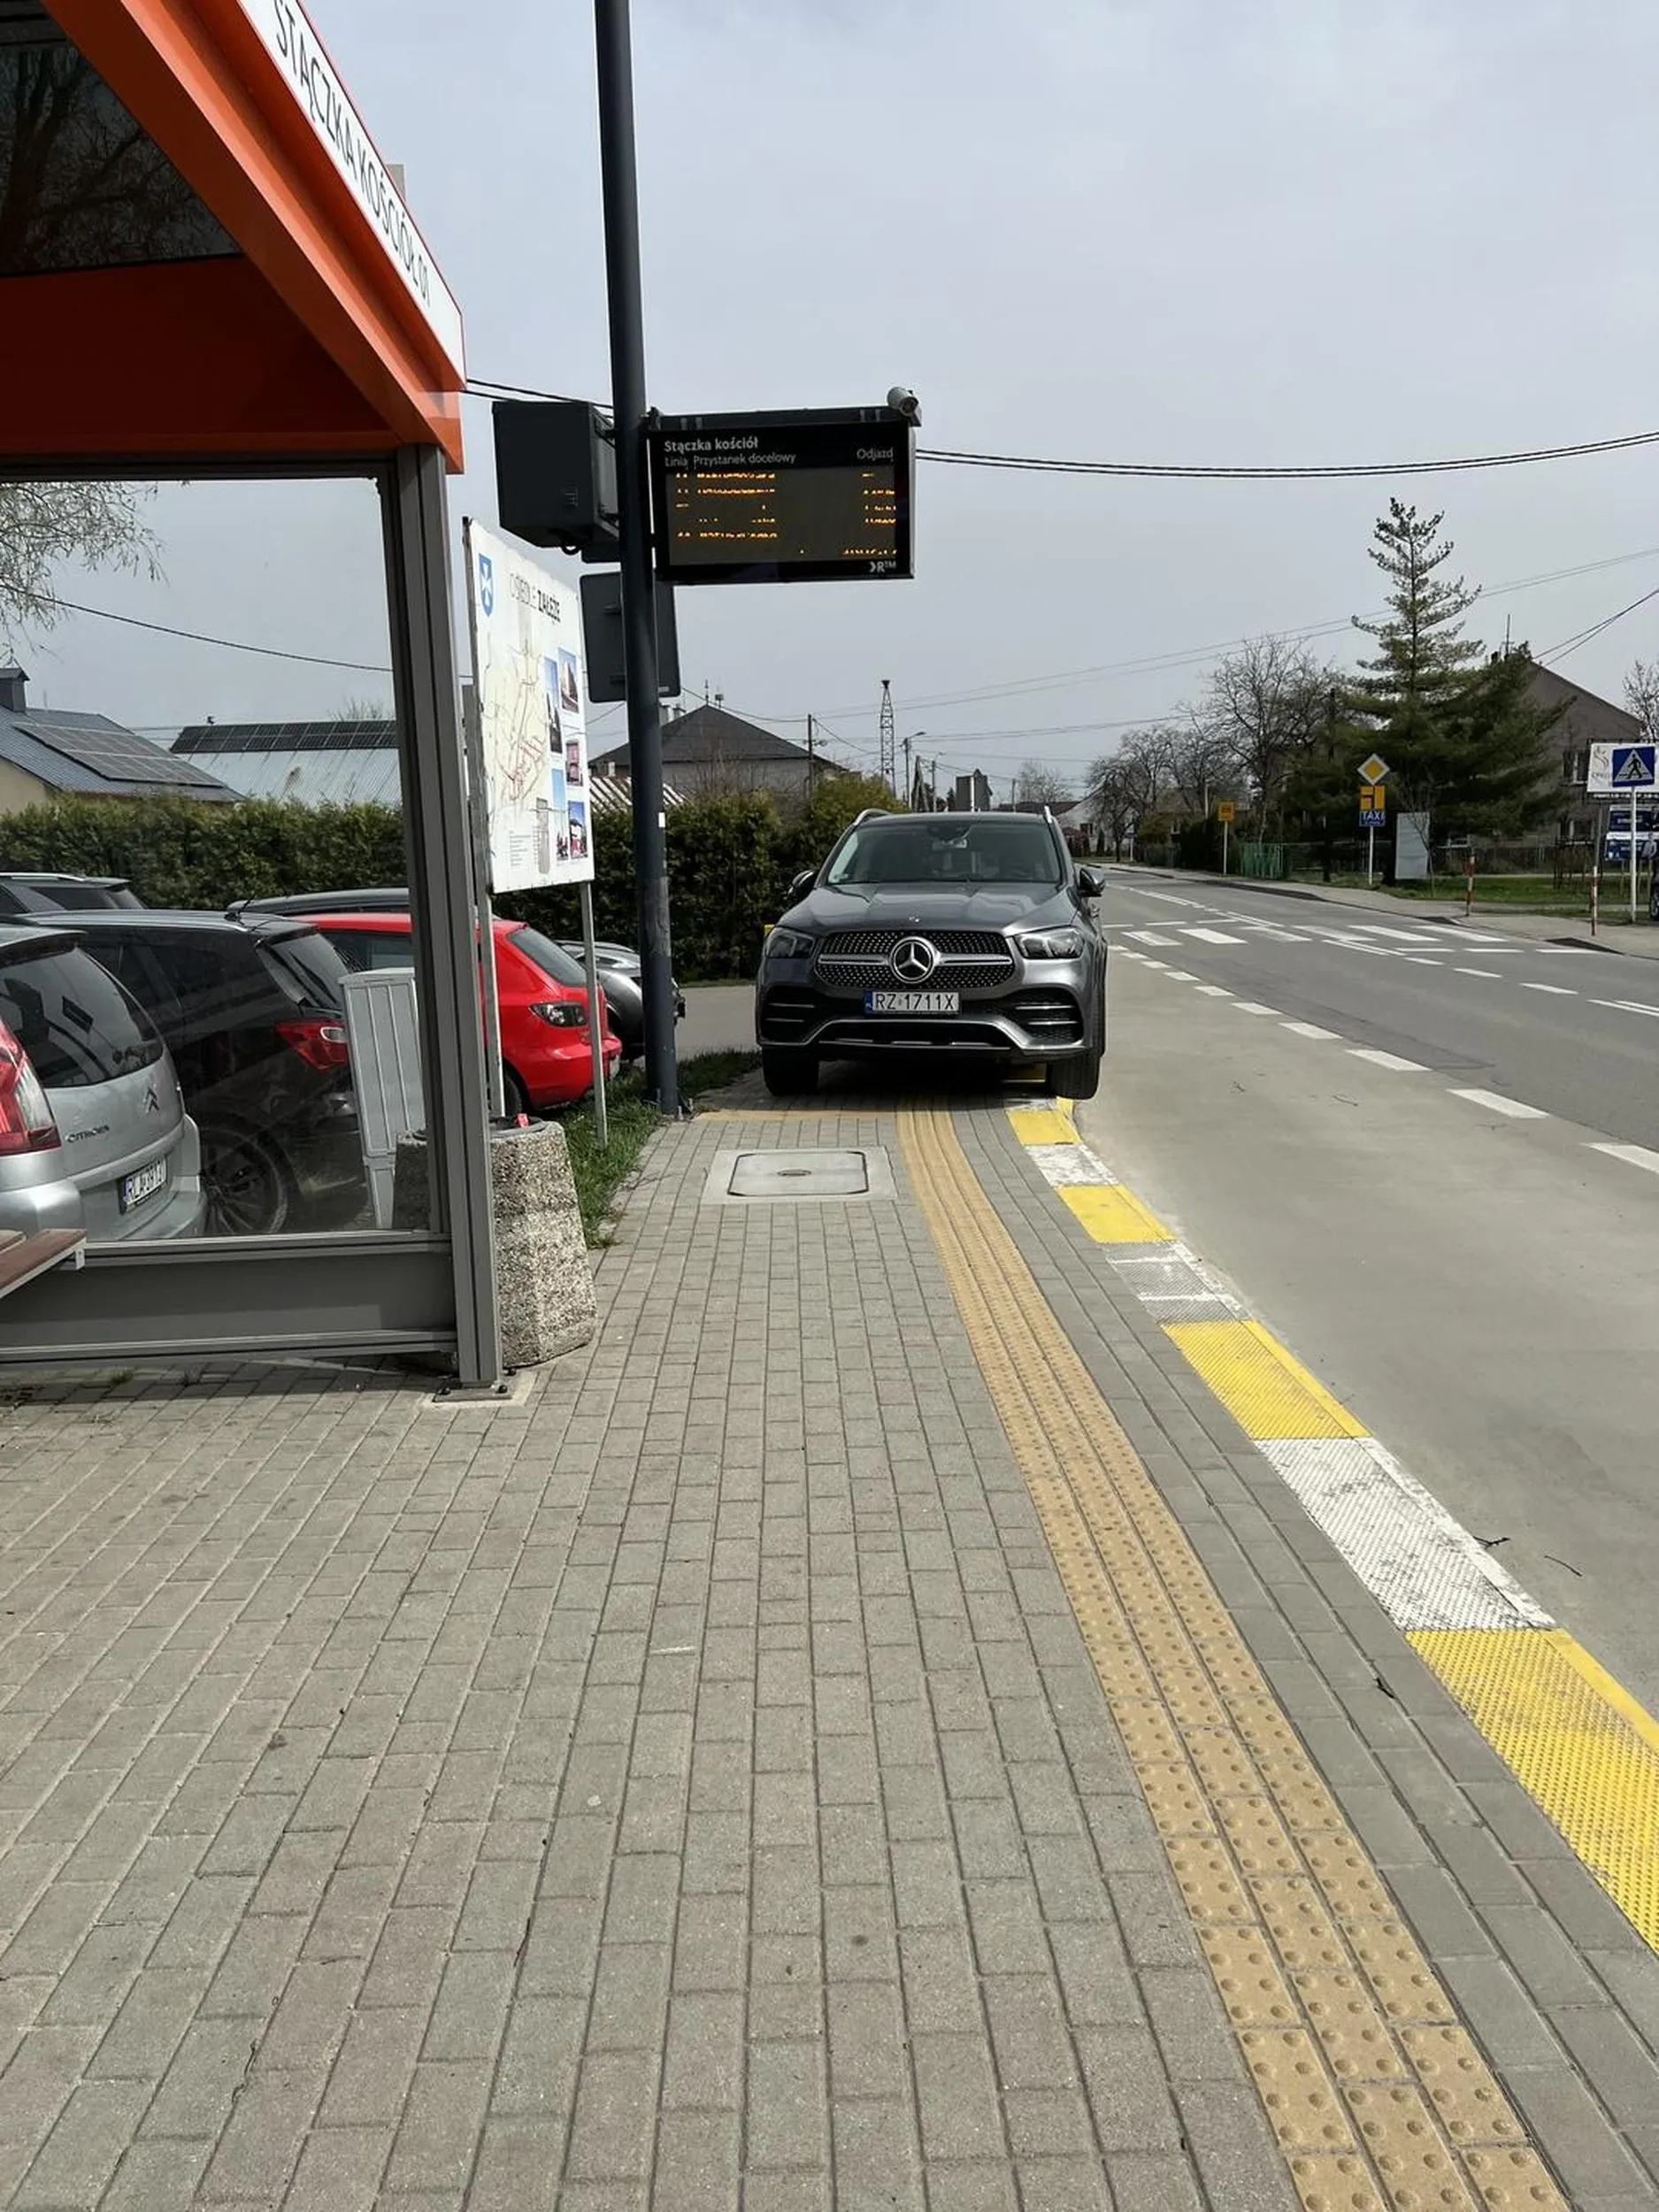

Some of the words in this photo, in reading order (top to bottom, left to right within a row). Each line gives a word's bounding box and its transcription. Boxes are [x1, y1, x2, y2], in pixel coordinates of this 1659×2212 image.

[273, 0, 357, 180] STĄCZKA
[357, 138, 419, 288] KOŚCIÓŁ
[664, 438, 711, 454] Stączka
[715, 435, 758, 449] kościół
[664, 457, 688, 467] Linia
[693, 453, 746, 468] Przystanek
[748, 450, 796, 465] docelowy
[856, 447, 894, 461] Odjazd
[875, 993, 896, 1010] RZ
[904, 993, 954, 1010] 1711X
